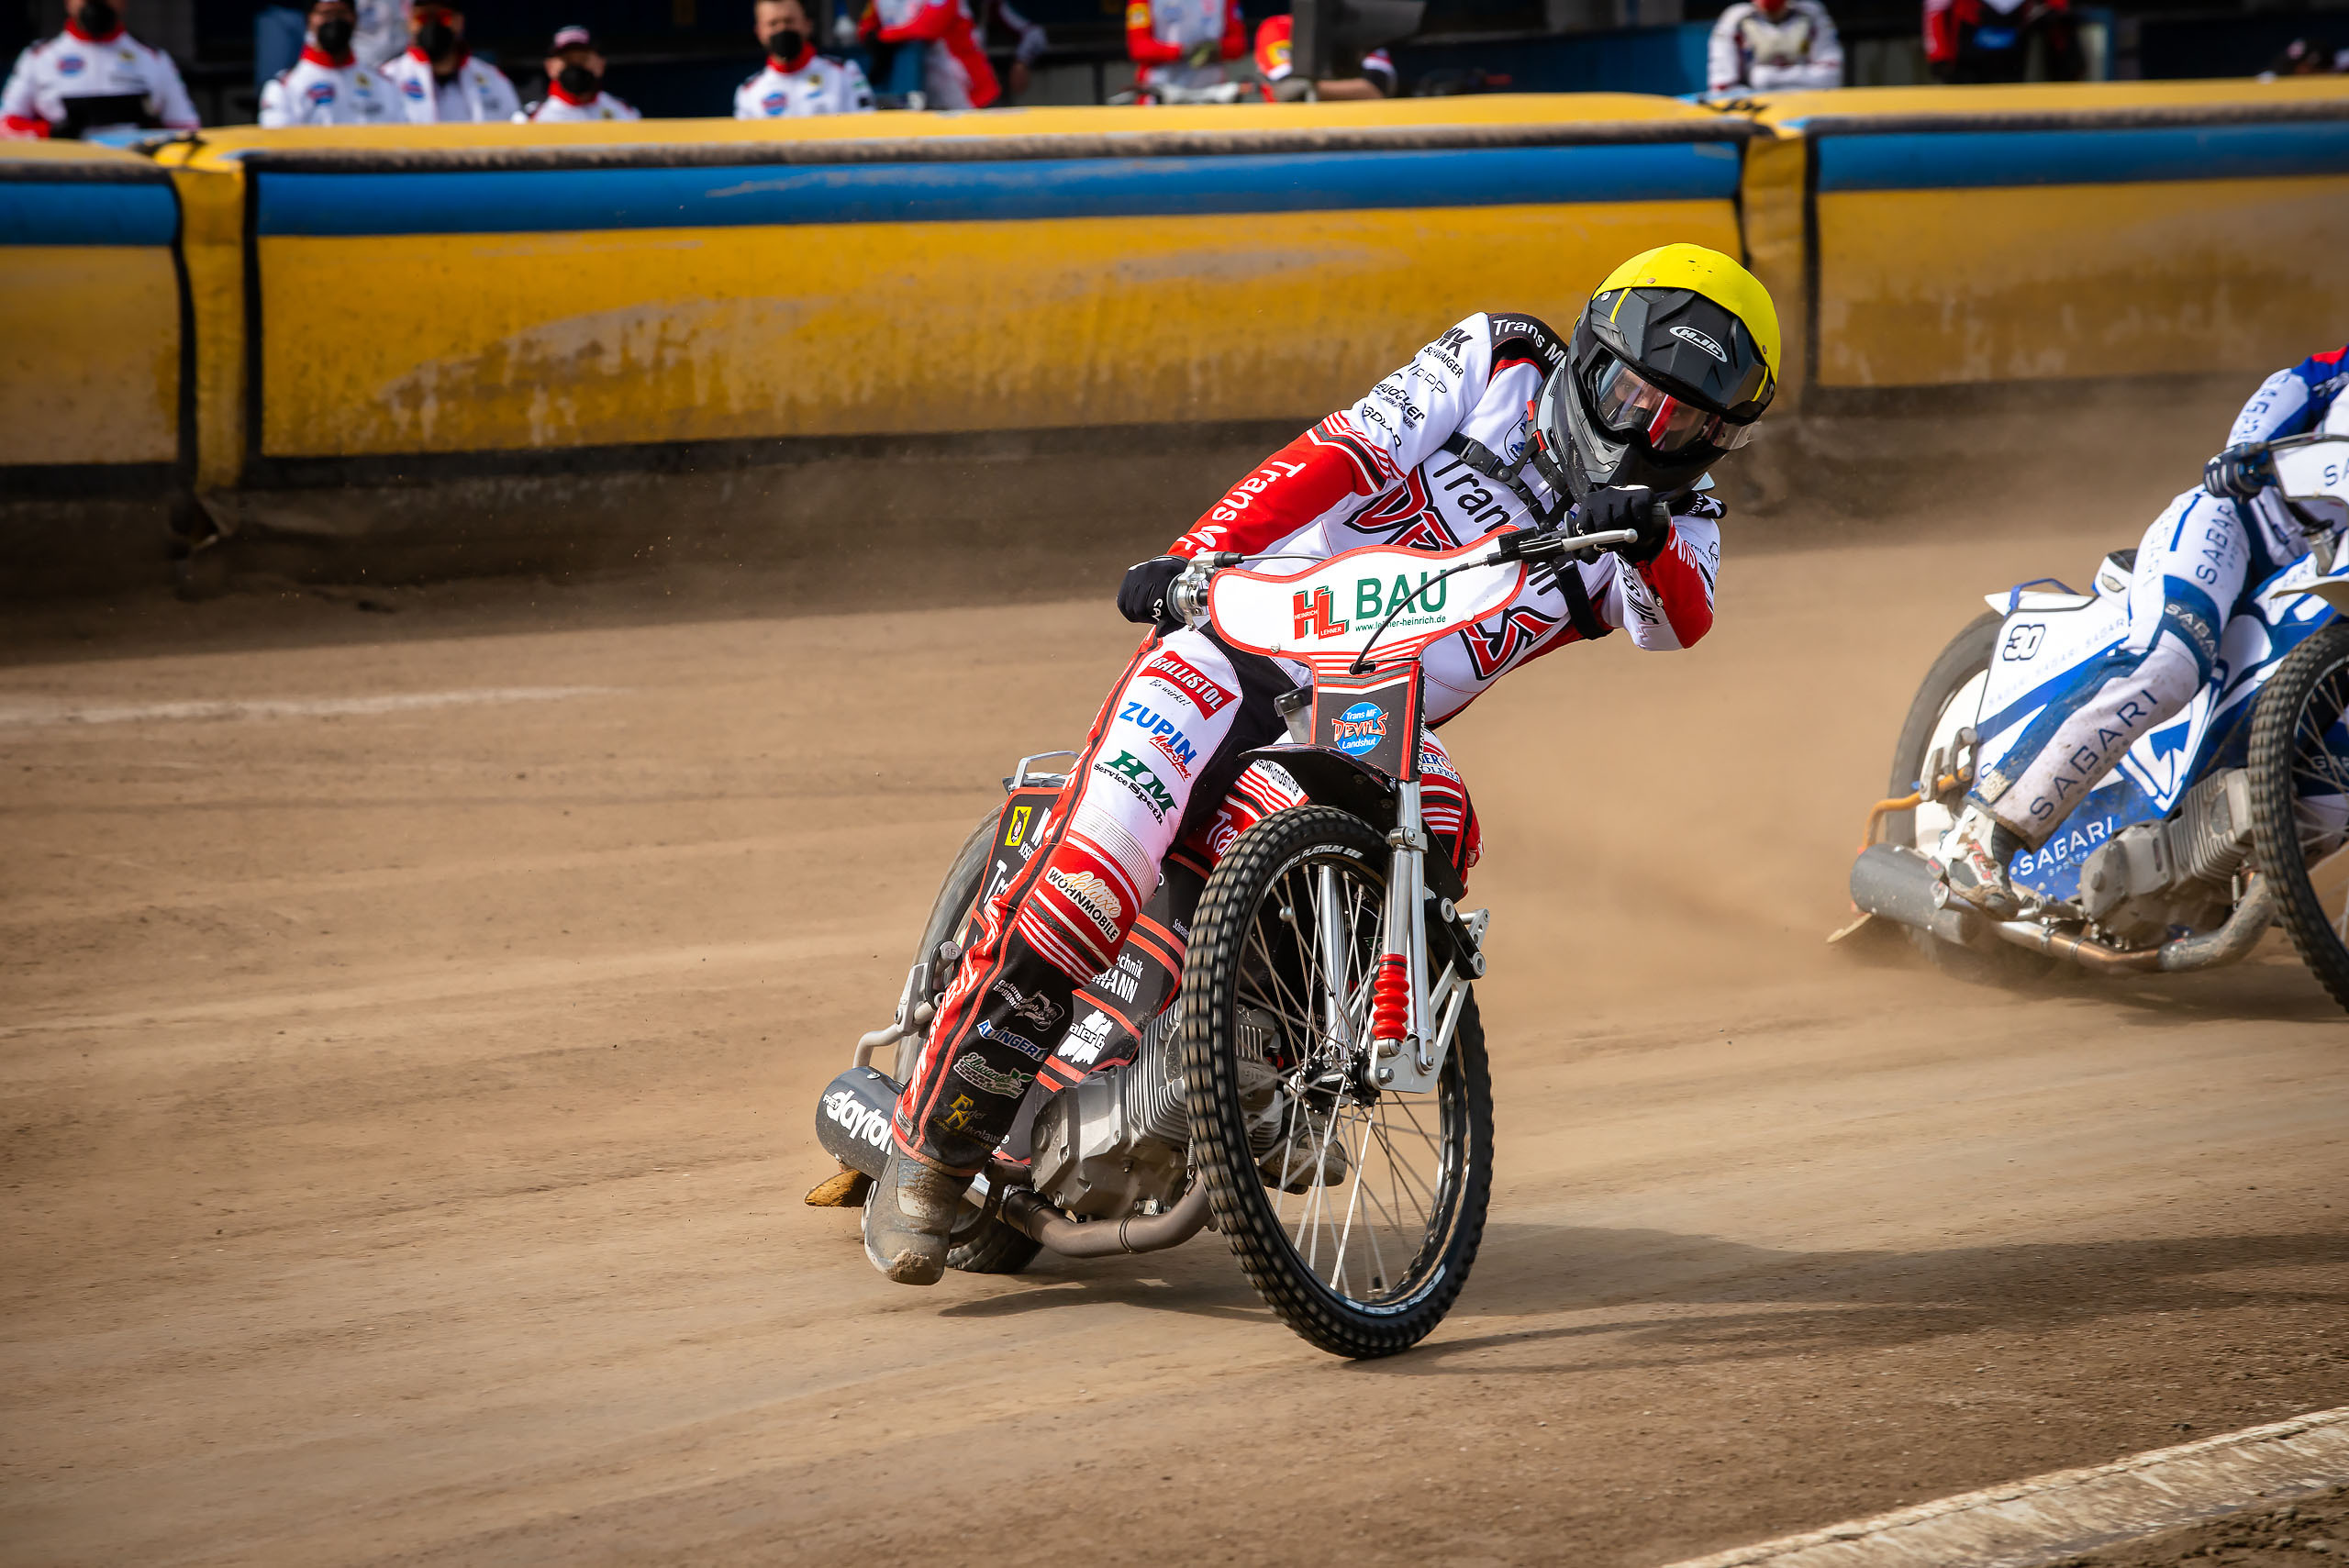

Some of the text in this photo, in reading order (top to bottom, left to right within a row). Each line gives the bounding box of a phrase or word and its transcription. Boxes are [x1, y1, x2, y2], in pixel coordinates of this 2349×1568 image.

[1424, 346, 1464, 379] SCHWAIGER
[1492, 318, 1565, 365] Trans M
[1680, 328, 1722, 357] HJC
[1212, 461, 1307, 521] Trans
[1294, 610, 1319, 620] HEINRICH
[1356, 569, 1447, 620] BAU
[1320, 626, 1342, 637] LEHNER
[1355, 615, 1447, 632] www.lener-heinrich.de
[2003, 623, 2046, 662] 30
[1151, 656, 1224, 711] BALLISTOL
[1119, 701, 1197, 765] ZUPIN
[1331, 712, 1389, 742] DEVILS
[1346, 708, 1377, 720] Trans MF
[1341, 737, 1376, 750] Landshut
[2029, 689, 2158, 821] SAGARI
[1093, 762, 1163, 827] Service Speth
[1207, 809, 1239, 855] Tra
[2020, 816, 2113, 877] SAGARI
[1048, 869, 1120, 940] WOHNMOBILE
[1070, 1022, 1096, 1044] aler
[827, 1089, 893, 1156] dayton
